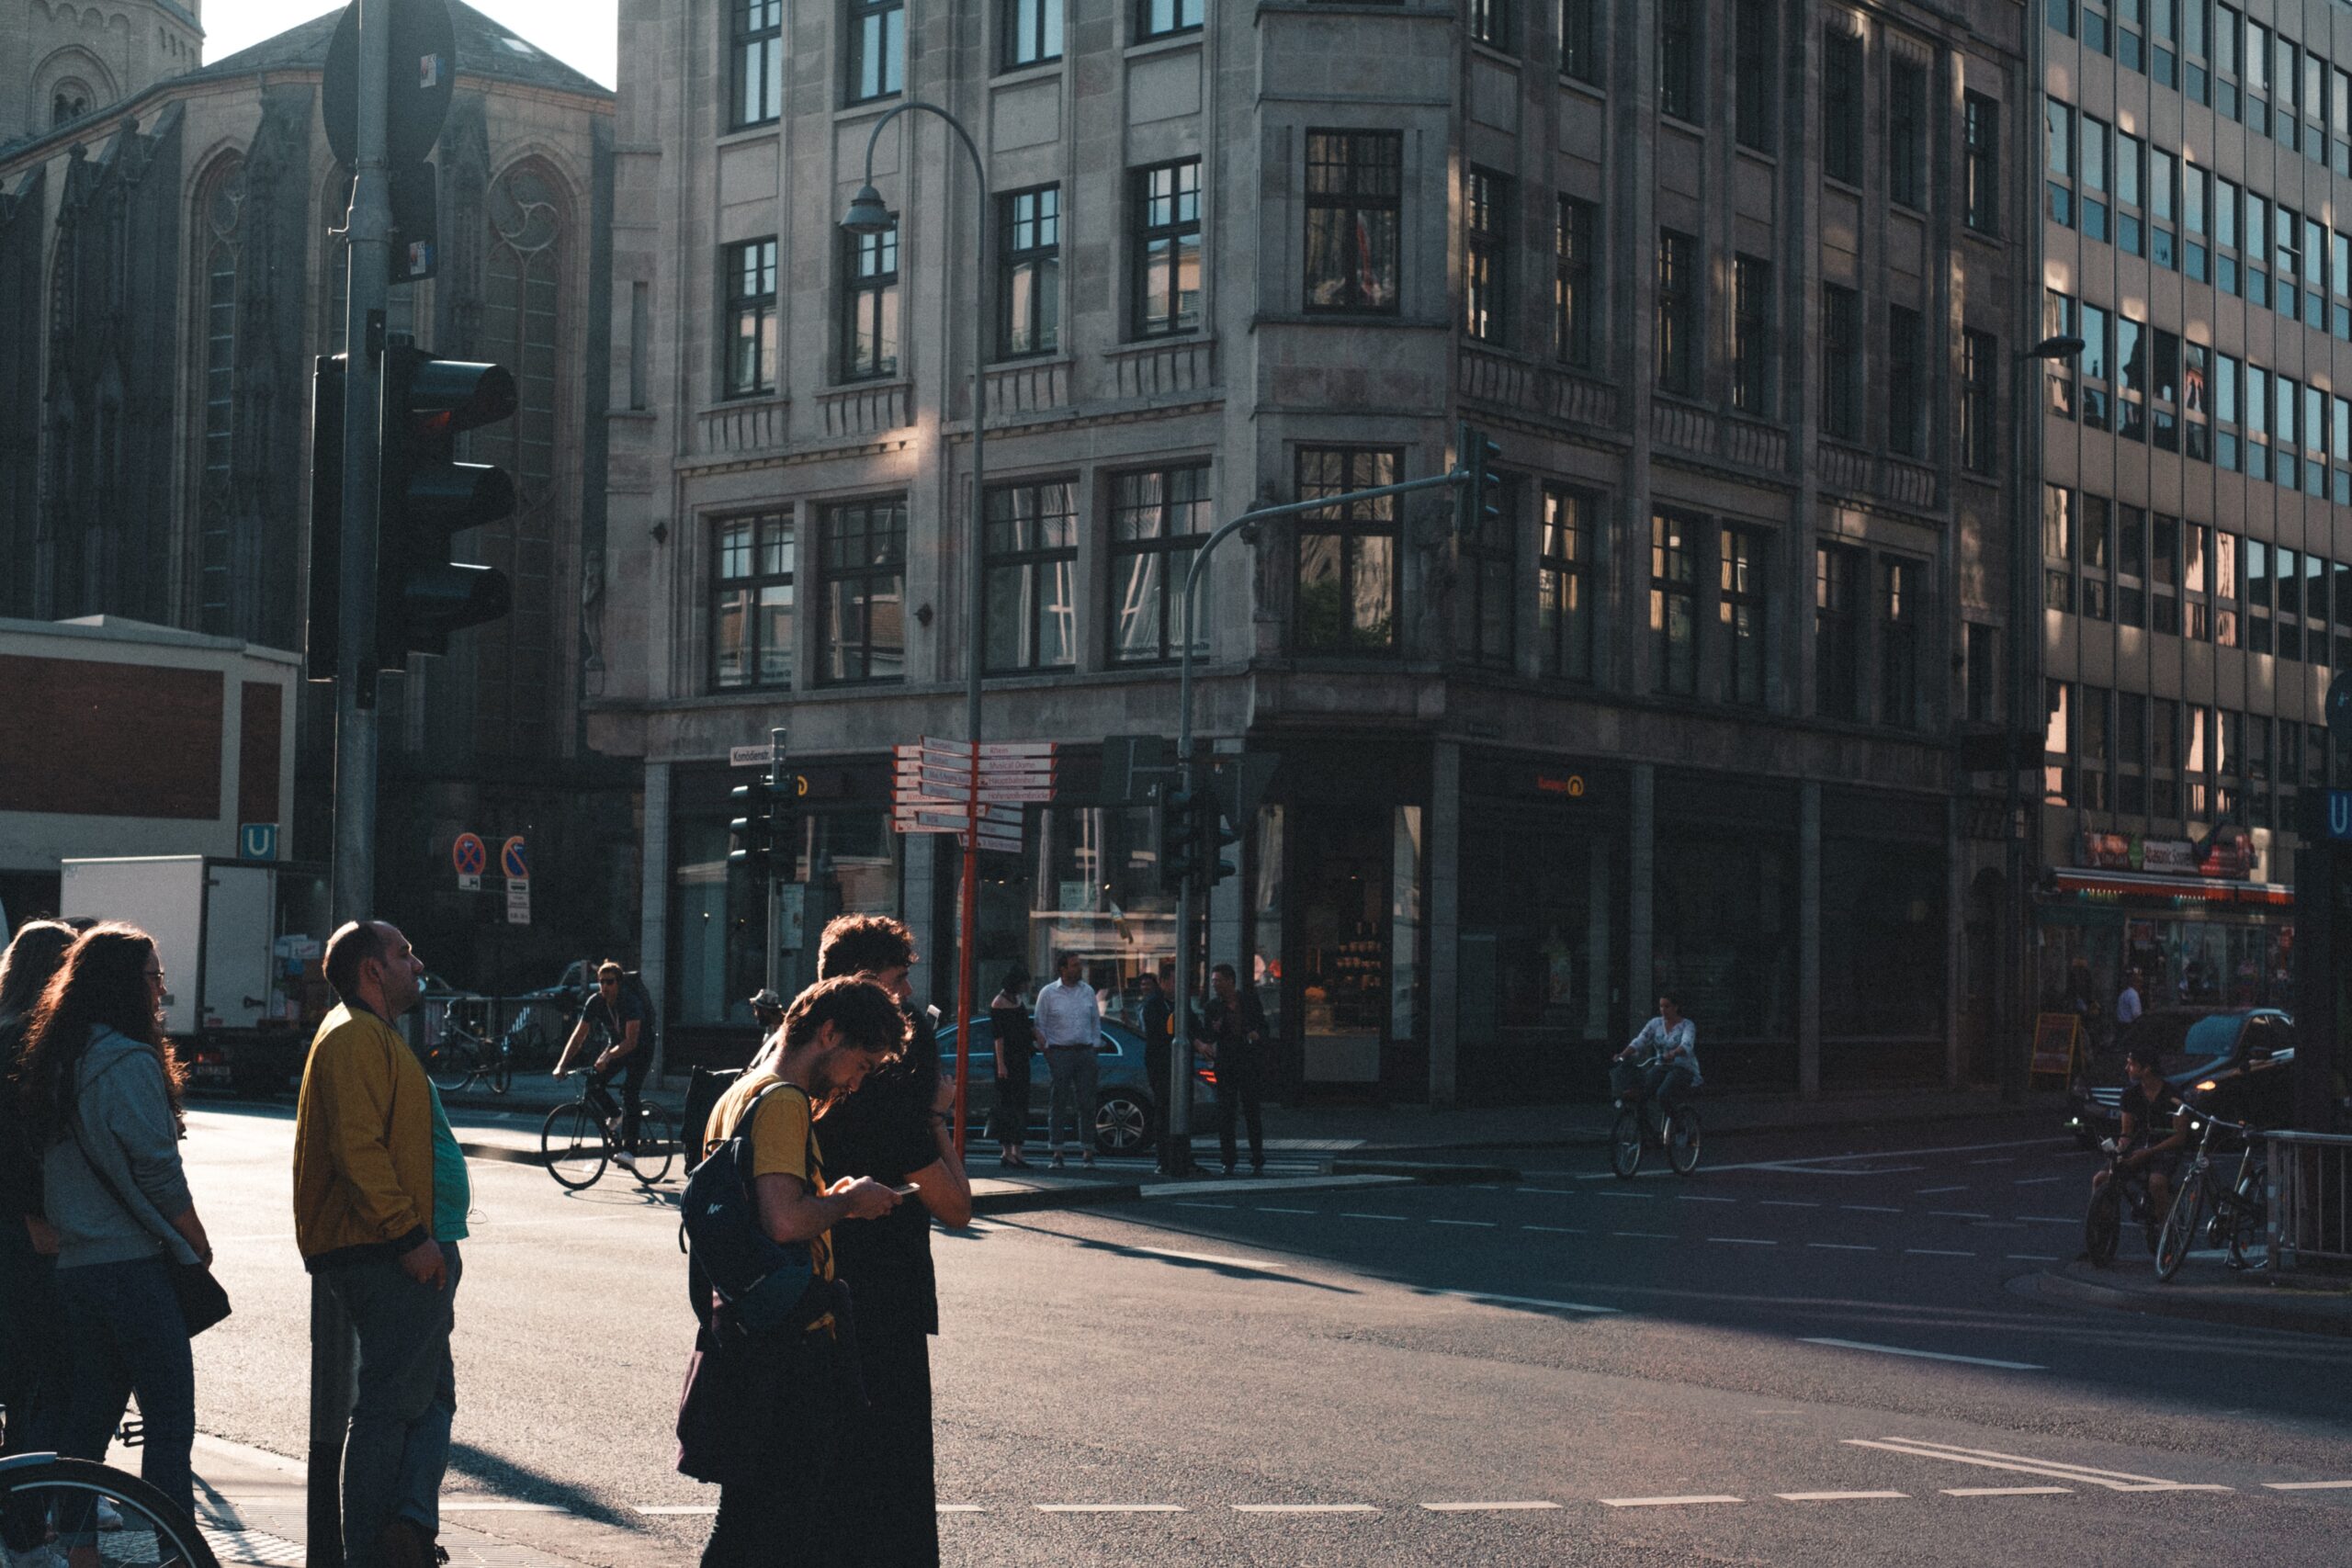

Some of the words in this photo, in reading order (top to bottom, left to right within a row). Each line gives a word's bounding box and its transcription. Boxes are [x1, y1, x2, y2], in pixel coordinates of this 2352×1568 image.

[989, 761, 1015, 770] Musical
[1016, 761, 1036, 770] Dome
[989, 776, 1035, 786] Hauptbahnhof
[988, 791, 1050, 800] Hohenzollernbrücke
[2330, 795, 2348, 834] U
[248, 829, 269, 856] U
